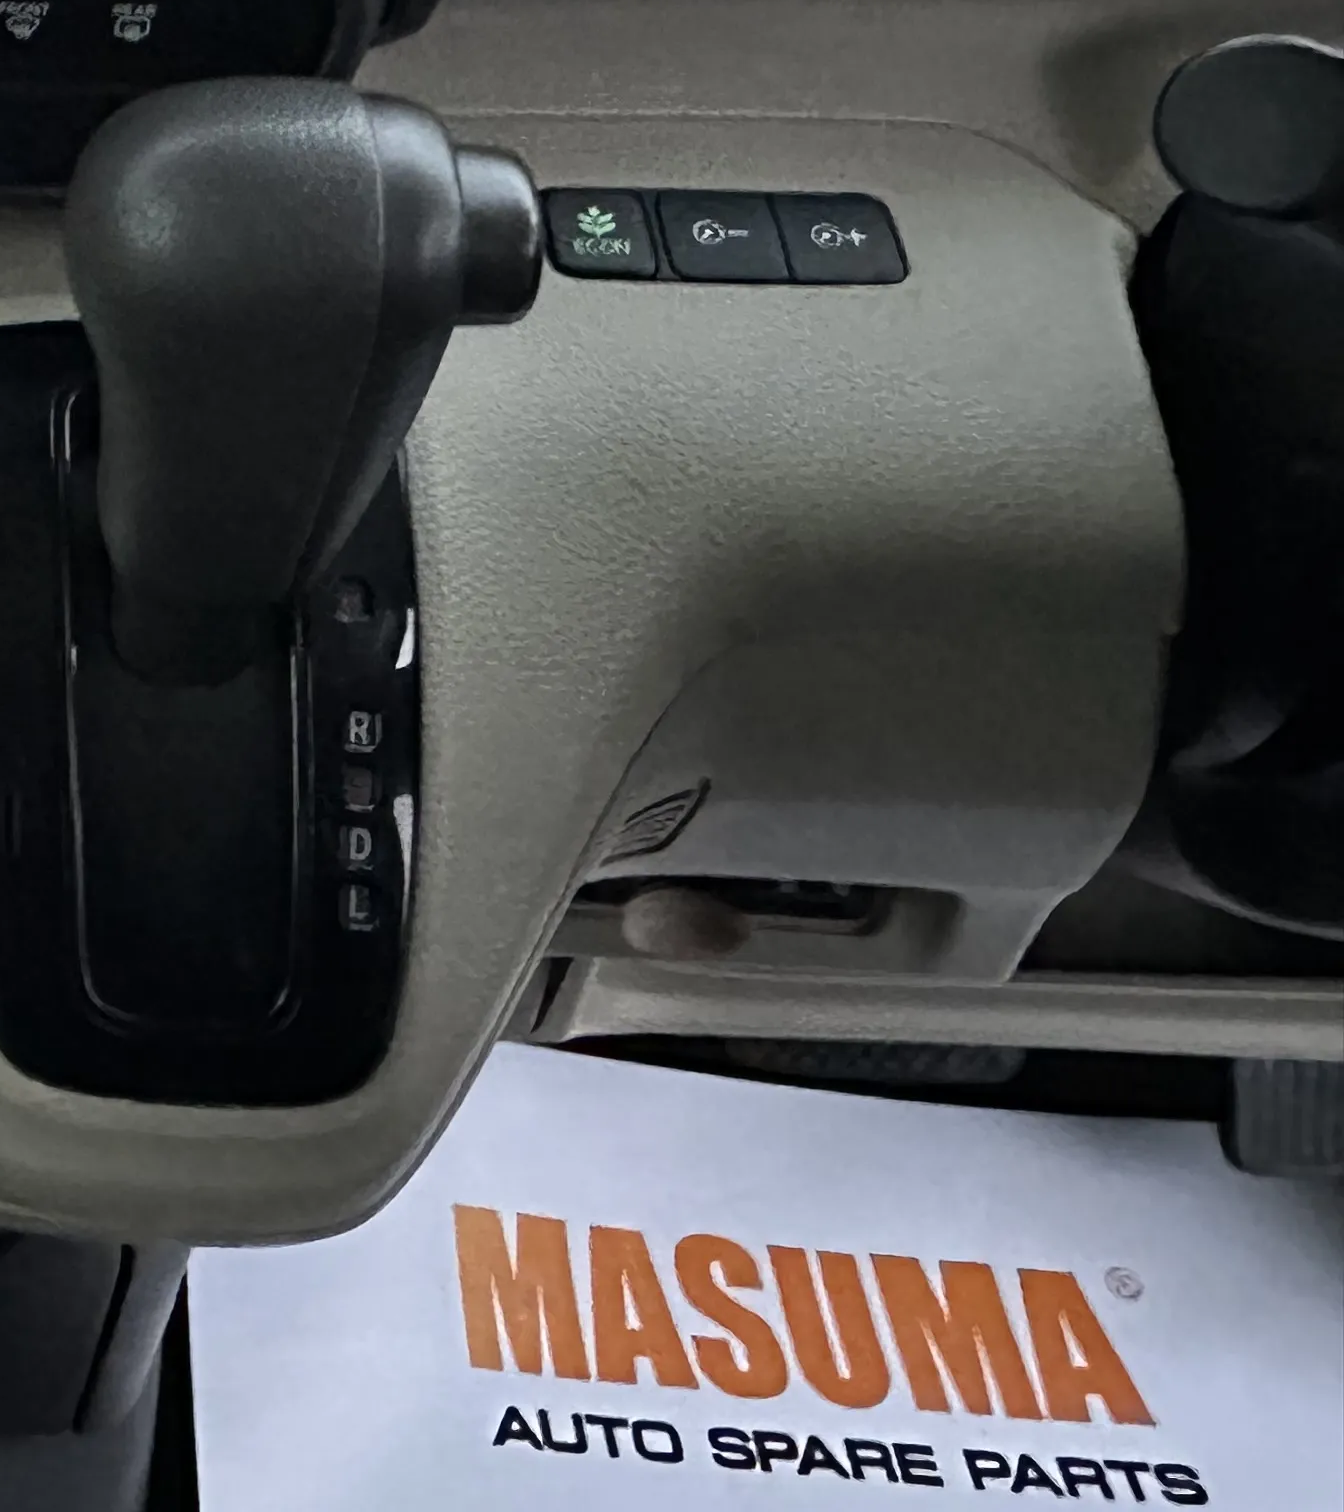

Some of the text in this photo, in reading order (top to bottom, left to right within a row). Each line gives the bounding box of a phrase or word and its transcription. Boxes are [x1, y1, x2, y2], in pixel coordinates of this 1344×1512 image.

[571, 236, 632, 256] ECON
[348, 711, 372, 745] R
[349, 826, 373, 861] D
[455, 1205, 1158, 1427] MASUMA
[492, 1405, 1210, 1506] AUTO SPARE PARTS
